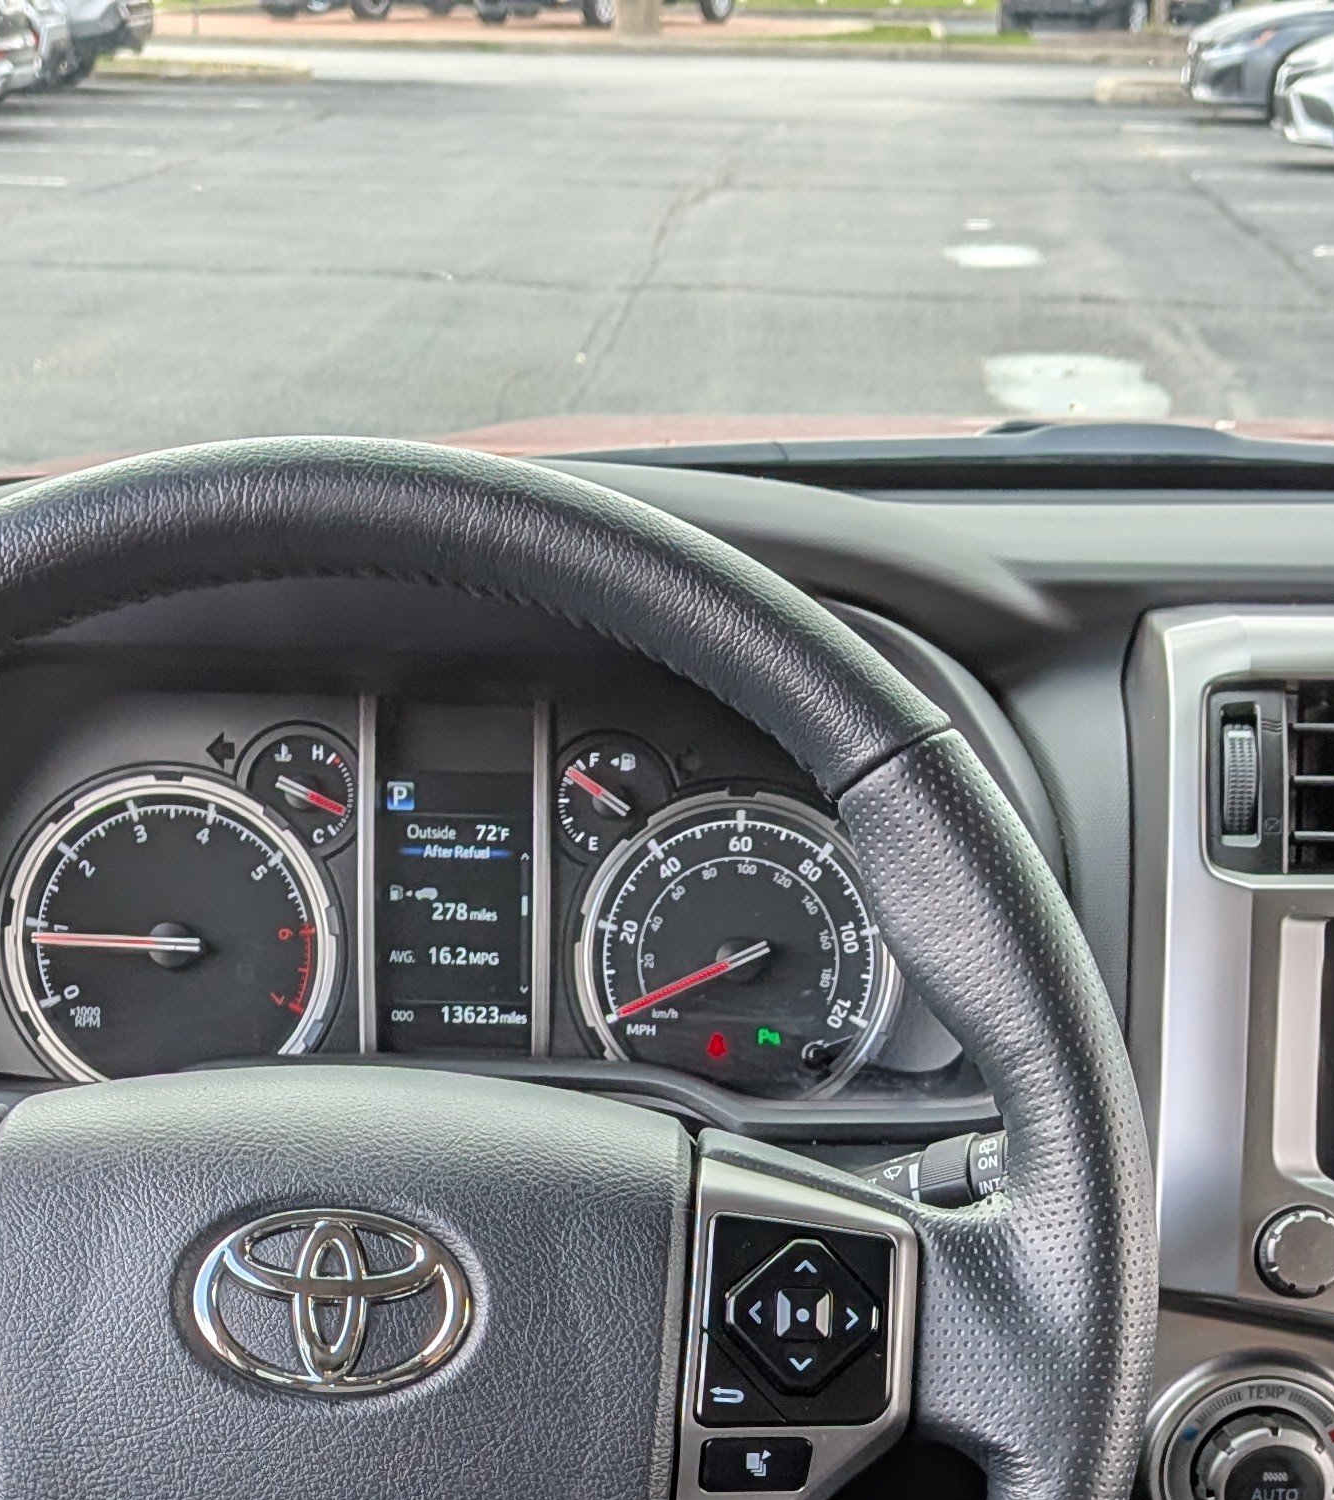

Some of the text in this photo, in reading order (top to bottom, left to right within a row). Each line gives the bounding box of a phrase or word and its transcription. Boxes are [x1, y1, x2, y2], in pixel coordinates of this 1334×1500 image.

[311, 745, 324, 761] H
[589, 752, 601, 768] F
[393, 786, 408, 807] P
[133, 825, 148, 844] 3
[196, 827, 210, 844] 4
[312, 828, 325, 844] C
[406, 824, 510, 842] Outside 72°F
[423, 844, 491, 860] After Refuel
[588, 836, 599, 851] E
[728, 835, 753, 852] 60
[78, 859, 96, 878] 2
[251, 863, 268, 881] 5
[658, 856, 682, 880] 40
[701, 867, 717, 881] 80
[737, 863, 758, 876] 100
[798, 858, 823, 883] 80
[772, 870, 793, 889] 120
[670, 885, 686, 901] 60
[432, 902, 499, 922] 278 miles
[800, 894, 819, 916] 140
[53, 922, 69, 932] 1
[619, 918, 640, 945] 20
[650, 915, 664, 932] 40
[278, 926, 294, 942] 6
[818, 928, 832, 951] 160
[839, 920, 859, 954] 100
[388, 946, 500, 966] AVG. 16.2 MPG
[643, 952, 655, 969] 20
[818, 966, 833, 989] 180
[63, 984, 80, 1000] 0
[74, 1016, 101, 1028] RPM
[441, 1005, 499, 1024] 13623
[499, 1010, 528, 1025] miles
[651, 1007, 679, 1020] km/h
[826, 998, 852, 1029] 120
[626, 1023, 657, 1037] MPH
[977, 1155, 998, 1170] ON
[977, 1177, 1001, 1196] INT
[1248, 1384, 1286, 1400] TEMP
